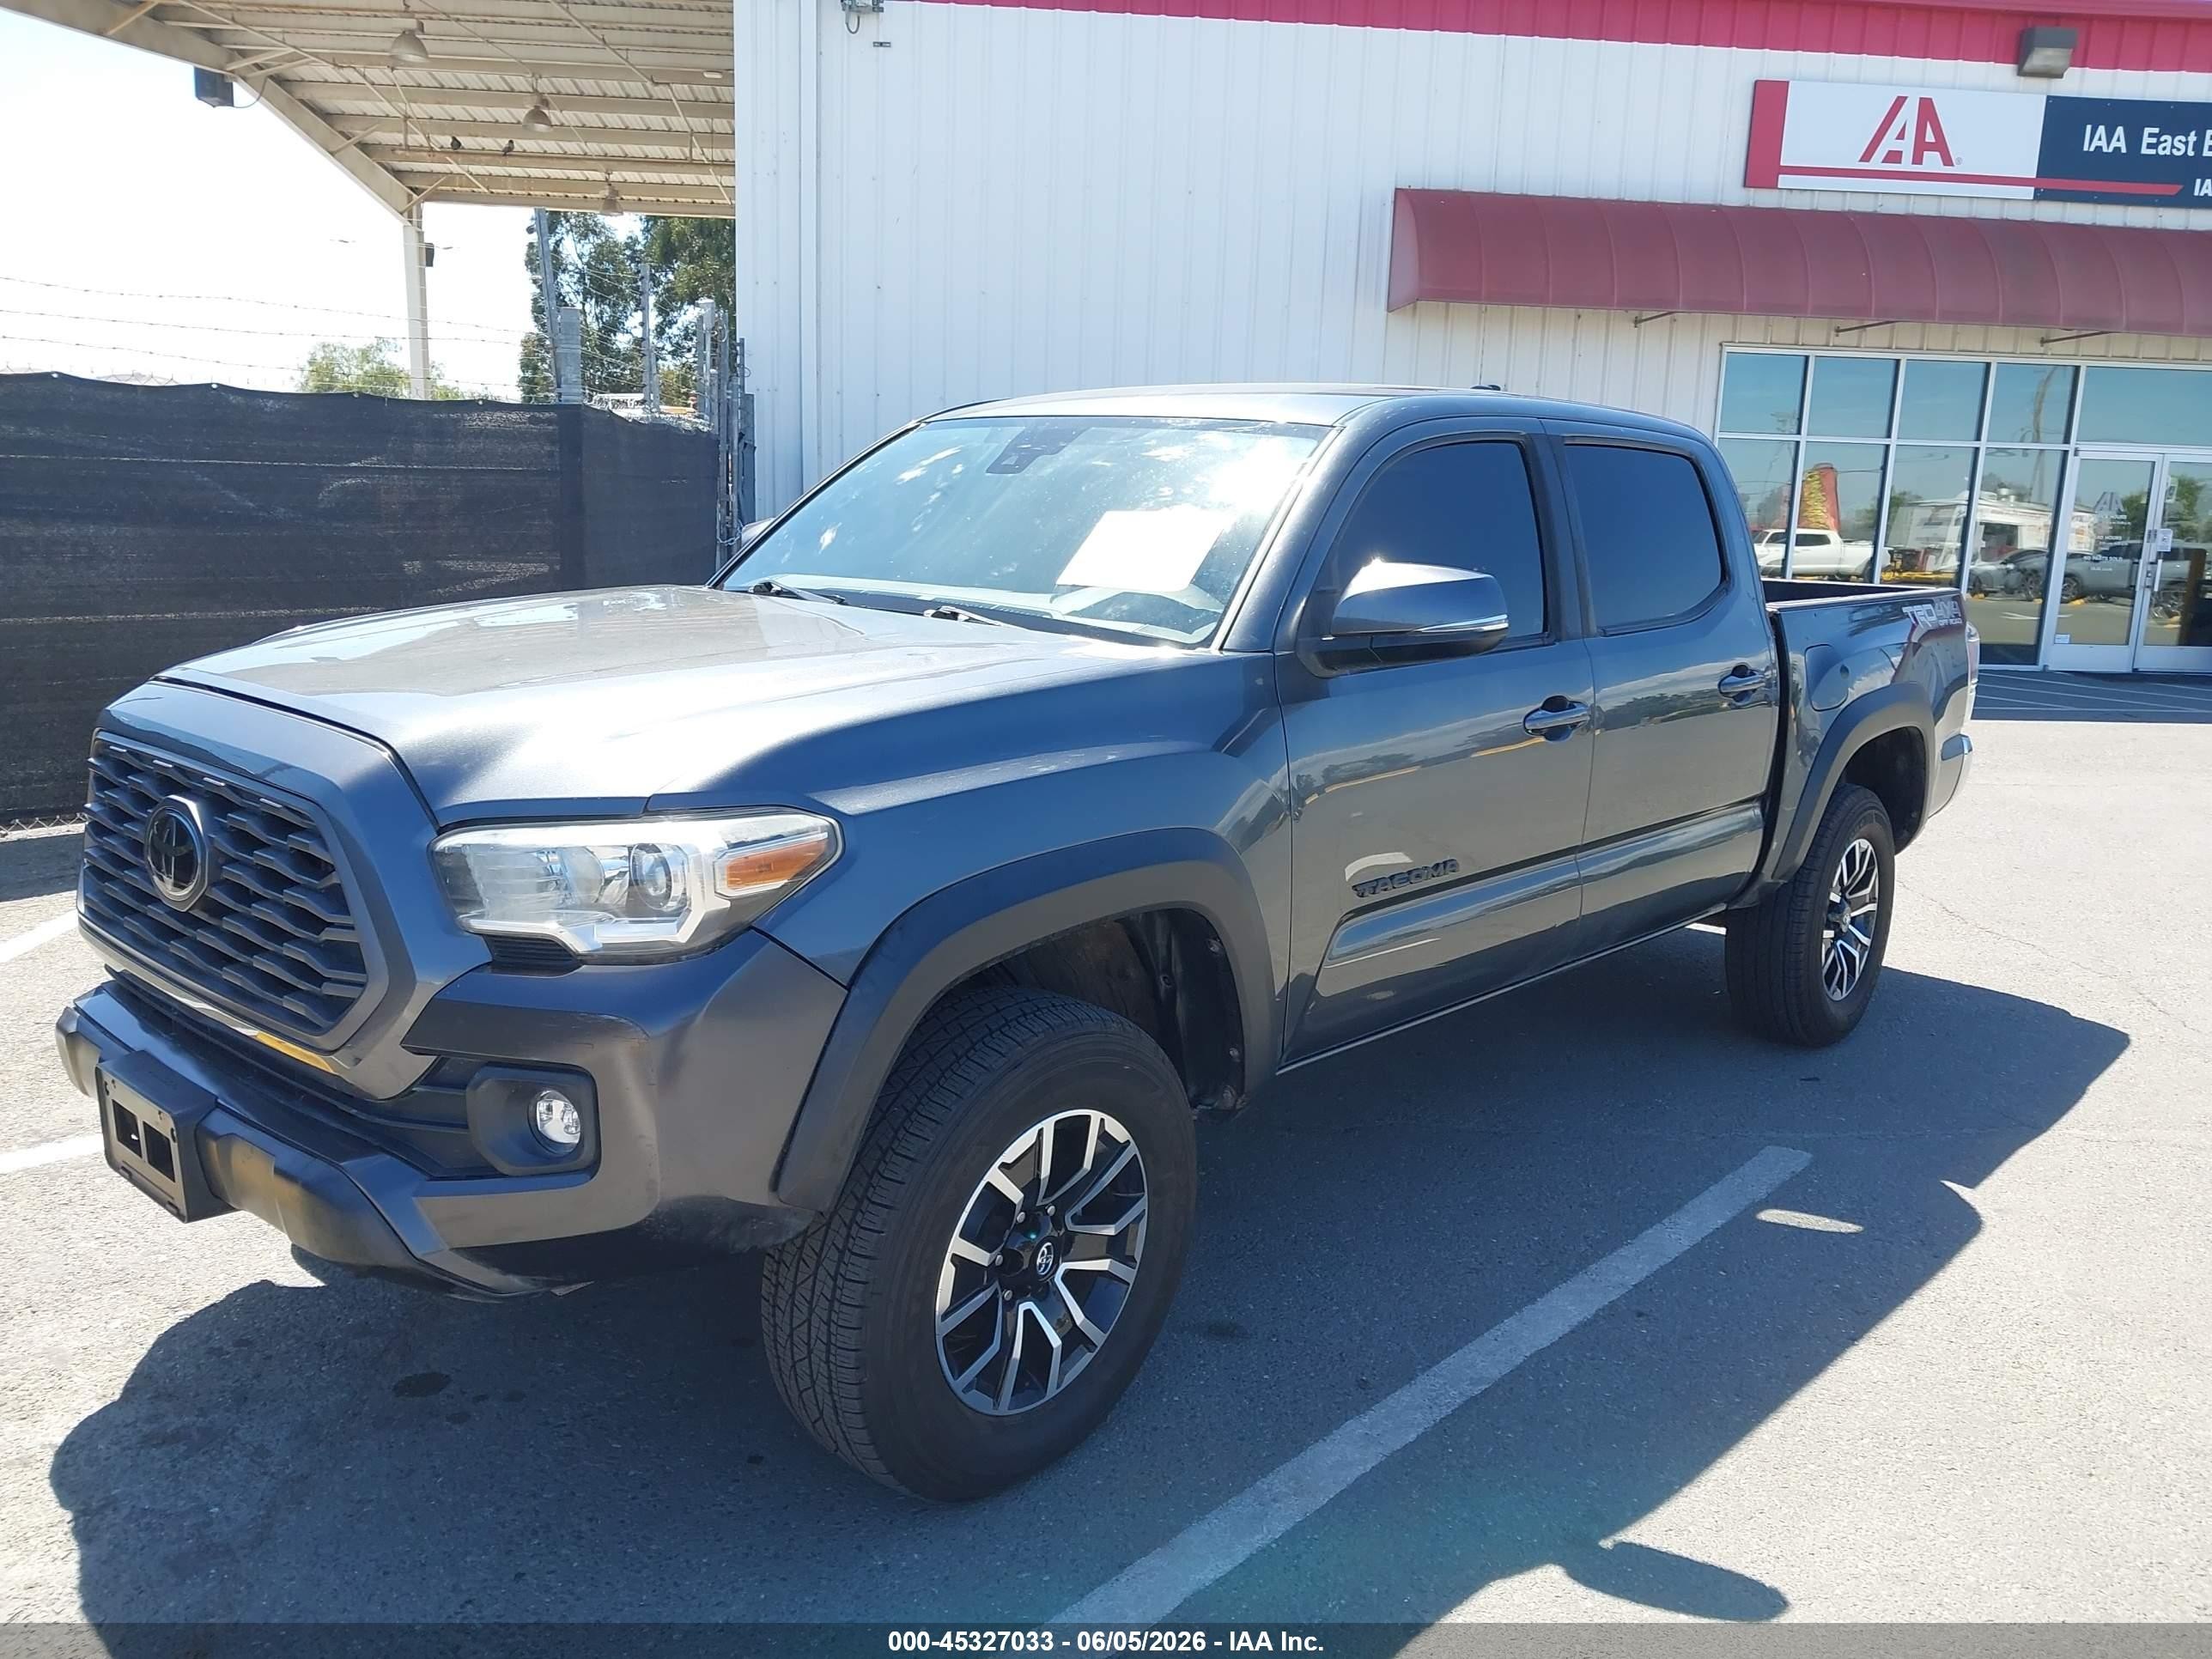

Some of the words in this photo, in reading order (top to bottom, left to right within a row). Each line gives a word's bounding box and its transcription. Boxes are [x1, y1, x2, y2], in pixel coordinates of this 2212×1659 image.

[2082, 124, 2128, 154] IAA
[2140, 126, 2197, 156] East
[1902, 604, 1936, 628] TRD
[1352, 859, 1459, 897] TACOMA
